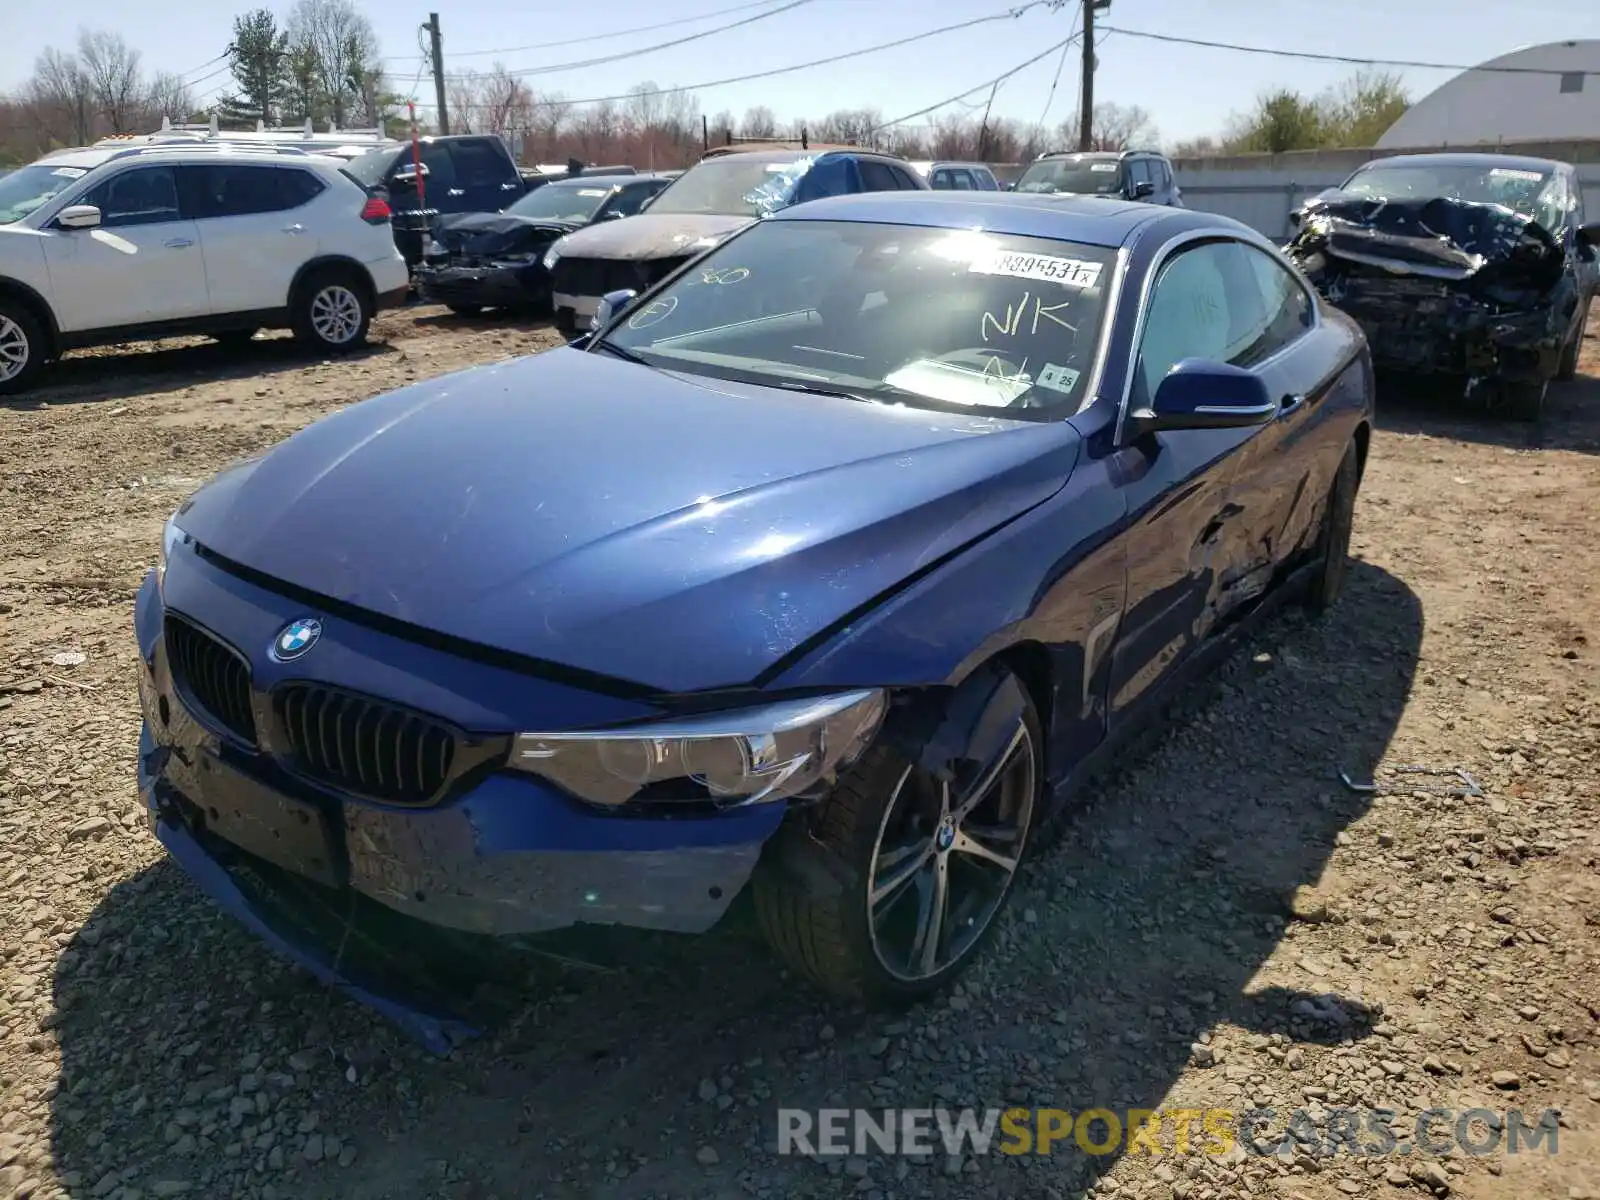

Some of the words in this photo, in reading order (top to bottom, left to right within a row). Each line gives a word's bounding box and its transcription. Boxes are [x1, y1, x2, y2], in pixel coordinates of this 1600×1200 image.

[981, 291, 1079, 341] N/K
[1045, 371, 1053, 381] 4
[1059, 375, 1073, 386] 25
